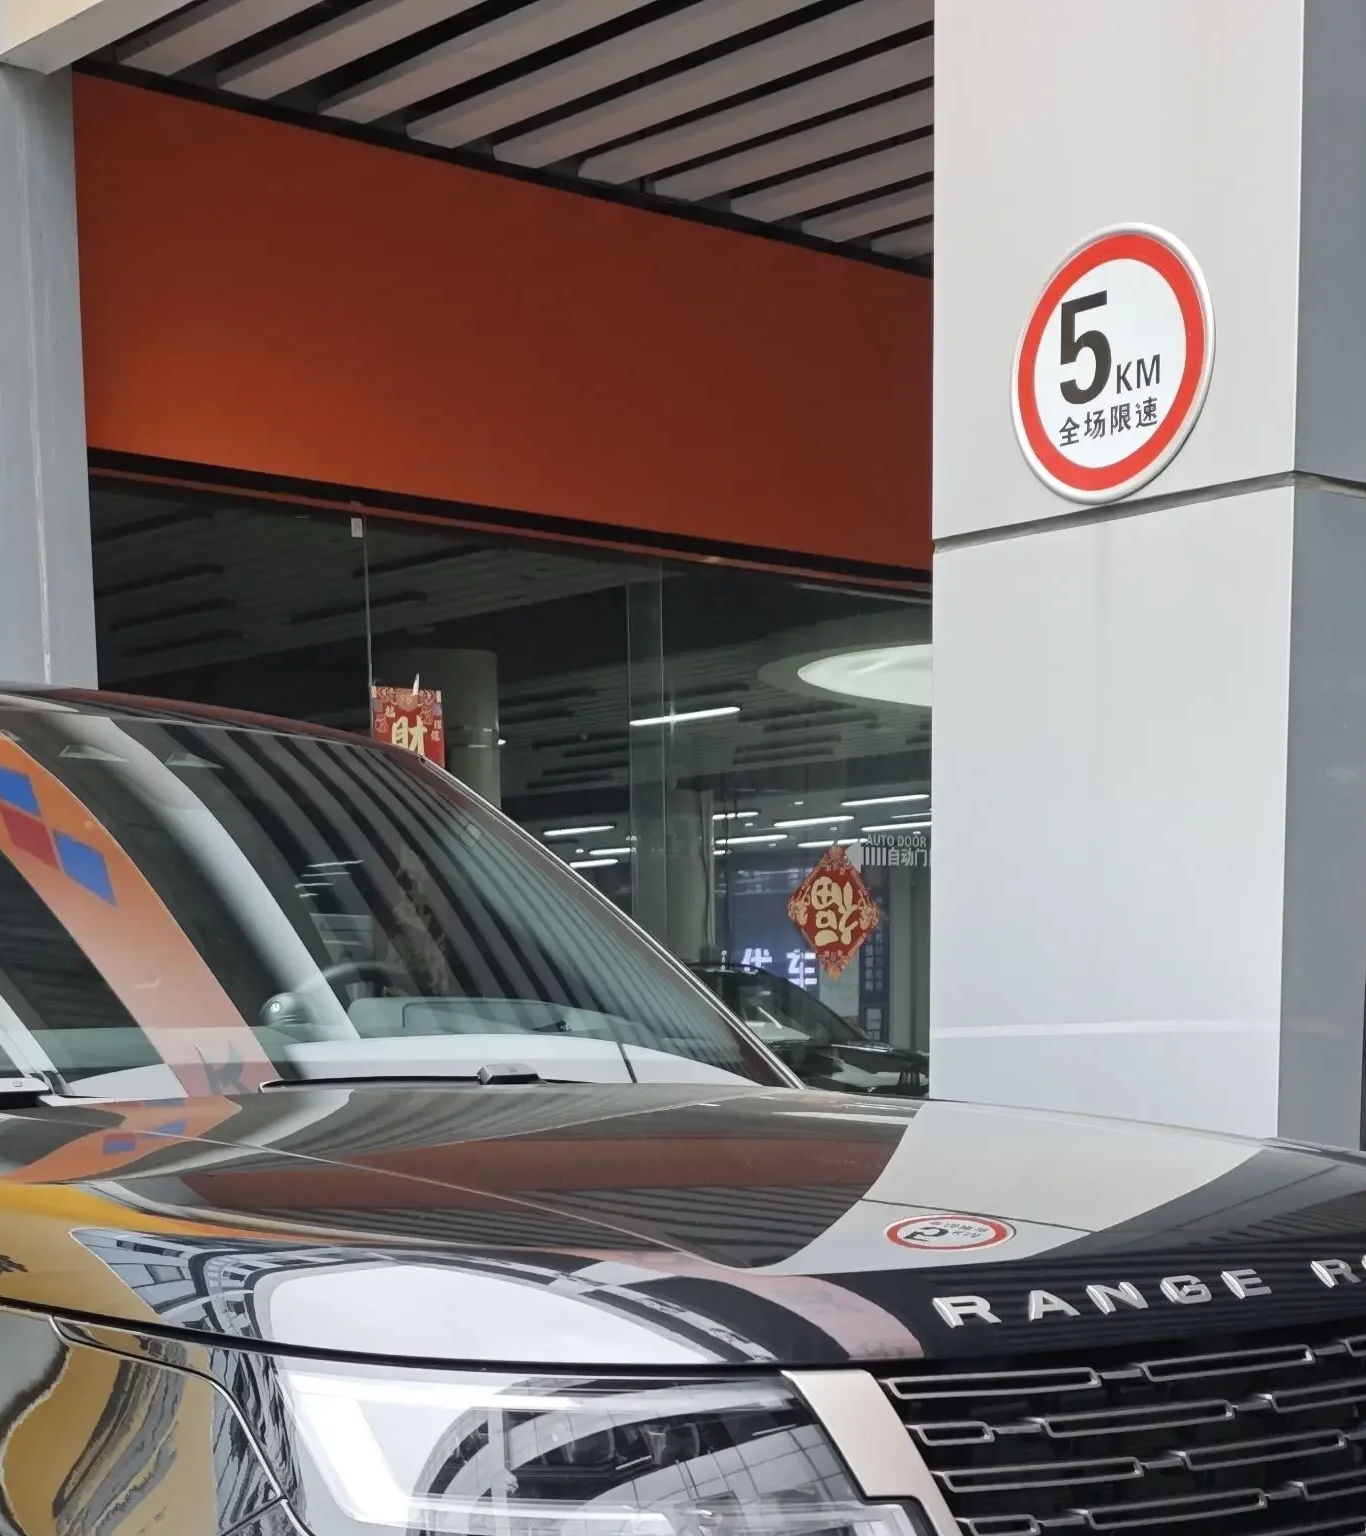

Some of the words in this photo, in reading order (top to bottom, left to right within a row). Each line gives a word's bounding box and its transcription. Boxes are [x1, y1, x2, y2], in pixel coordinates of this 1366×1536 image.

[1059, 396, 1159, 447] 全场限速
[866, 834, 895, 847] AUTO
[897, 835, 927, 848] DOOR
[888, 846, 928, 867] 自动门
[933, 1269, 1272, 1328] RANGE
